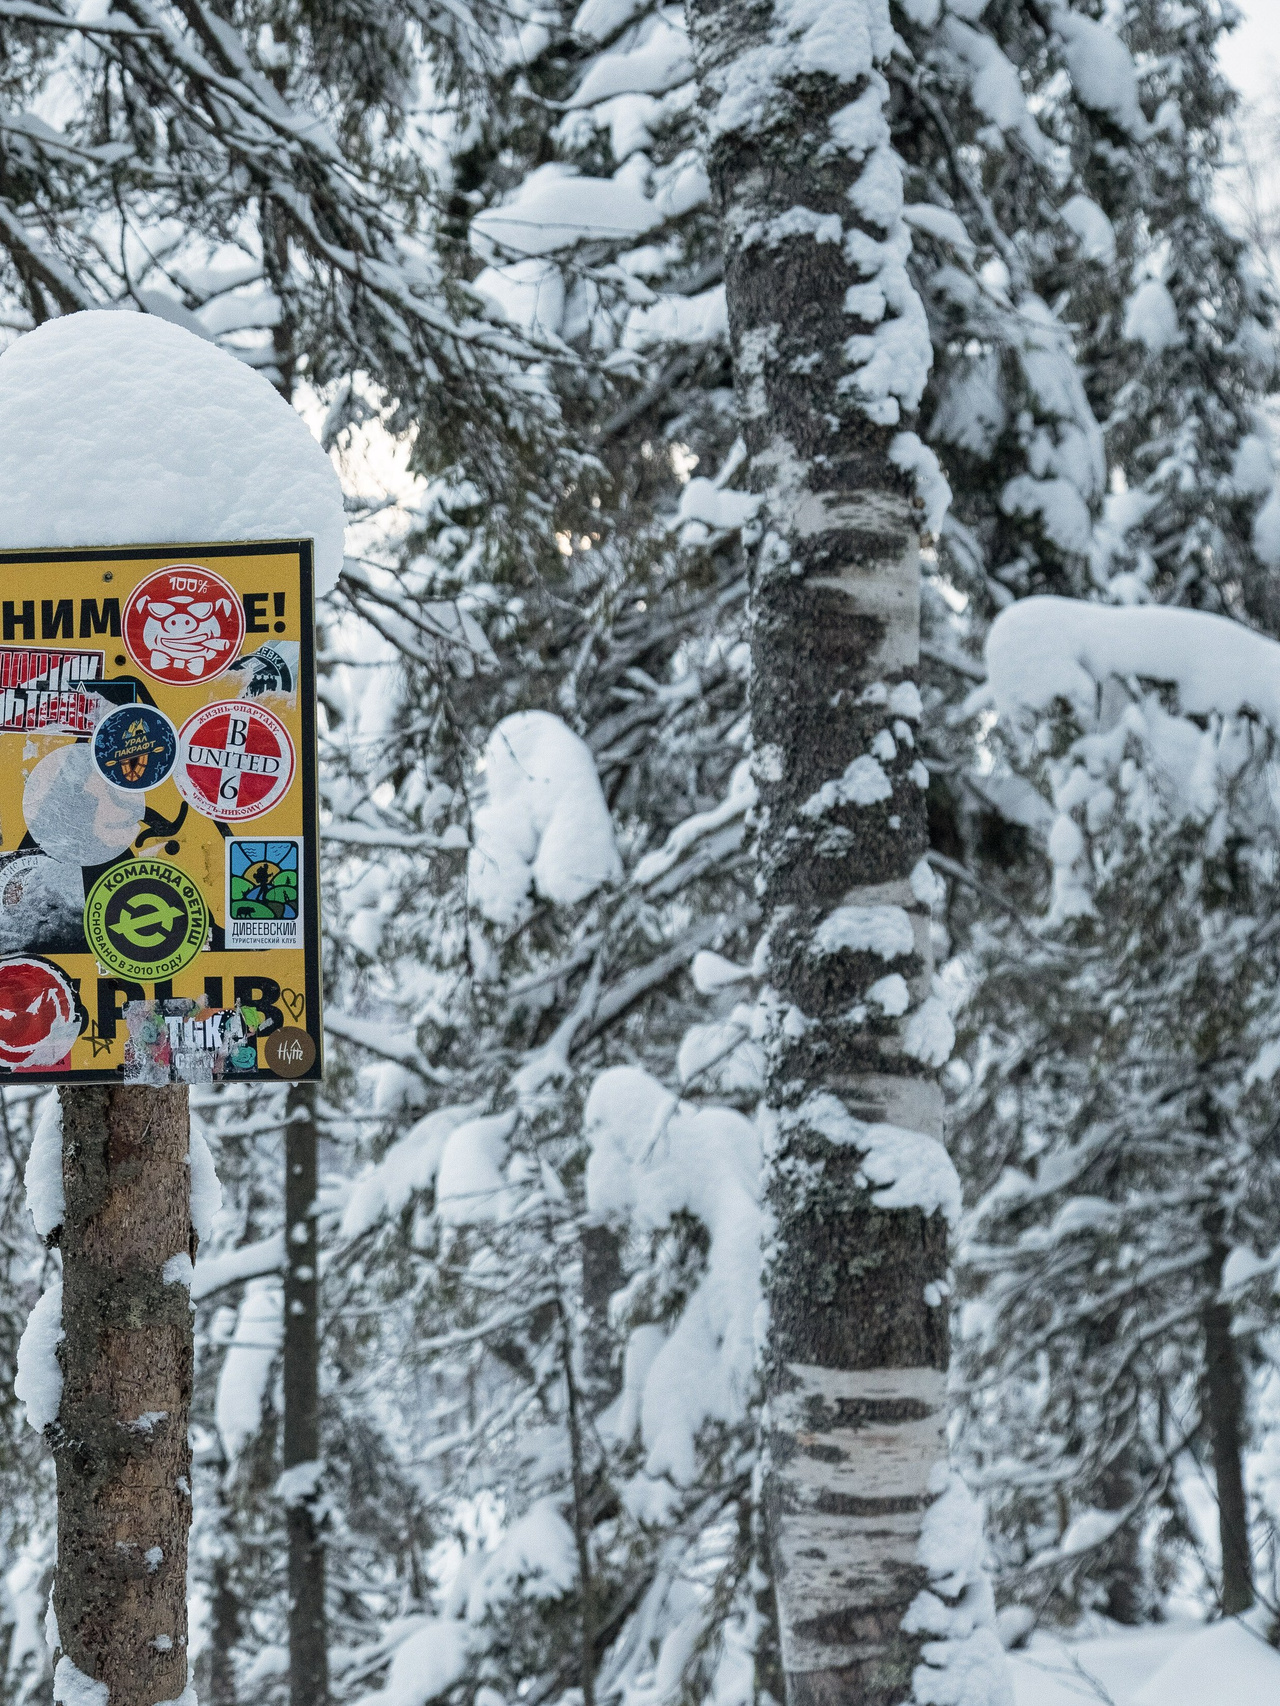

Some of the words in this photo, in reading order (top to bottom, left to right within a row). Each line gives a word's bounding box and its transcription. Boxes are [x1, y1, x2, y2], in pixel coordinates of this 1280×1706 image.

[169, 577, 209, 593] 100%
[114, 740, 156, 758] ПАКРАФТ
[125, 735, 148, 748] УРАЛ
[188, 746, 280, 774] UNITED
[220, 775, 239, 800] 6
[103, 864, 183, 893] КОМАНДА
[182, 886, 203, 947] ФЕТИШ
[231, 920, 297, 938] ДИВЕЕВСКИЙ
[92, 902, 118, 963] ОСНОВАНО
[118, 960, 126, 969] В
[127, 964, 153, 976] 2010
[156, 953, 183, 974] ГОДУ
[232, 937, 280, 945] ТУРИСТИЧЕСКИЙ
[282, 937, 297, 945] КЛУБ
